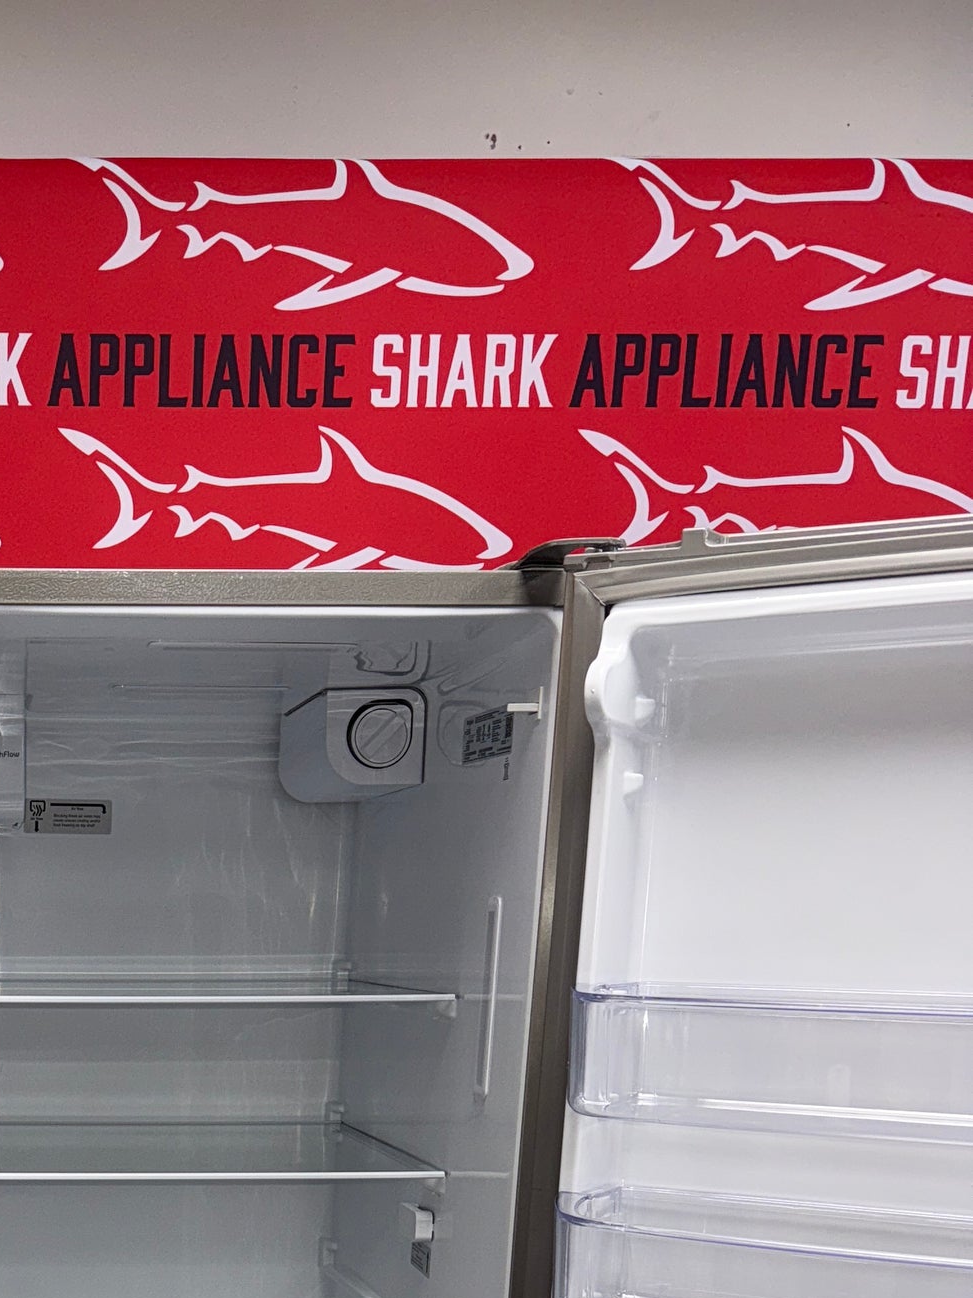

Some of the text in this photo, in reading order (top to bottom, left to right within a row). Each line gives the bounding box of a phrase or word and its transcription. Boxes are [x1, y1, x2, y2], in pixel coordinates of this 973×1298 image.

[48, 333, 355, 407] APPLIANCE
[370, 333, 558, 407] SHARK
[569, 333, 884, 408] APPLIANCE
[895, 334, 973, 409] SH
